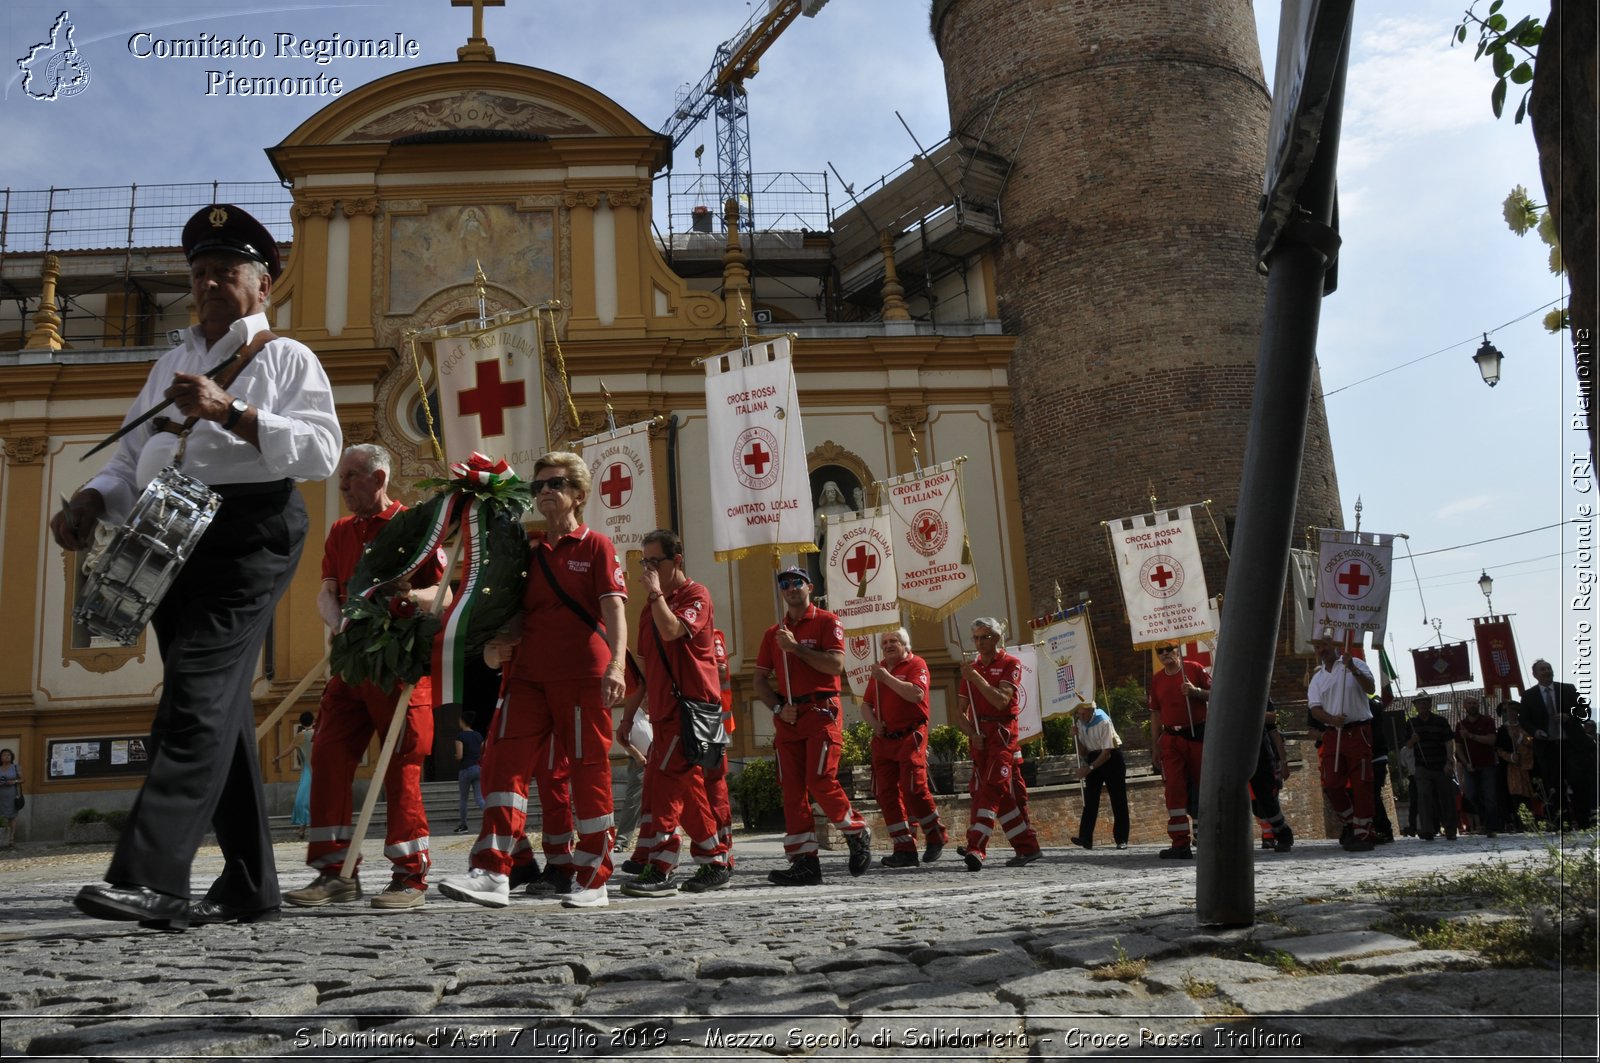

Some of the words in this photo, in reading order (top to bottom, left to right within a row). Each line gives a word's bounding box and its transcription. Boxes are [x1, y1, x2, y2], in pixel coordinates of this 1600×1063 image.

[440, 344, 466, 376] CROCE
[469, 334, 496, 352] ROSSA
[498, 332, 536, 360] ITALIANA
[727, 392, 750, 405] CROCE
[751, 386, 776, 400] ROSSA
[735, 401, 768, 416] ITALIANA
[504, 446, 546, 466] LOCALE
[601, 446, 620, 462] ROSSA
[622, 445, 646, 476] ITALIANA
[892, 482, 920, 496] CROCE
[924, 474, 950, 488] ROSSA
[903, 489, 943, 505] ITALIANA
[727, 502, 765, 518] COMITATO
[771, 499, 798, 511] LOCALE
[606, 514, 631, 526] GRUPPO
[746, 513, 780, 526] MONALE
[1125, 533, 1151, 544] CROCE
[1154, 527, 1182, 539] ROSSA
[830, 539, 844, 567] CROCE
[843, 527, 867, 542] ROSSA
[868, 528, 892, 559] ITALIANA
[1136, 538, 1172, 550] ITALIANA
[1324, 552, 1344, 573] CROCE
[1344, 549, 1364, 557] ROSSA
[1365, 553, 1386, 577] ITALIANA
[905, 563, 958, 580] MONTIGLIO
[901, 572, 966, 590] MONFERRATO
[832, 604, 874, 617] MONTEGROSSO
[1142, 607, 1196, 620] CASTELNUOVO
[1320, 602, 1355, 610] COMITATO
[1149, 619, 1164, 628] DON
[1168, 616, 1193, 625] BOSCO
[1174, 620, 1205, 630] MASSAIA
[1320, 619, 1359, 628] COCCONATO
